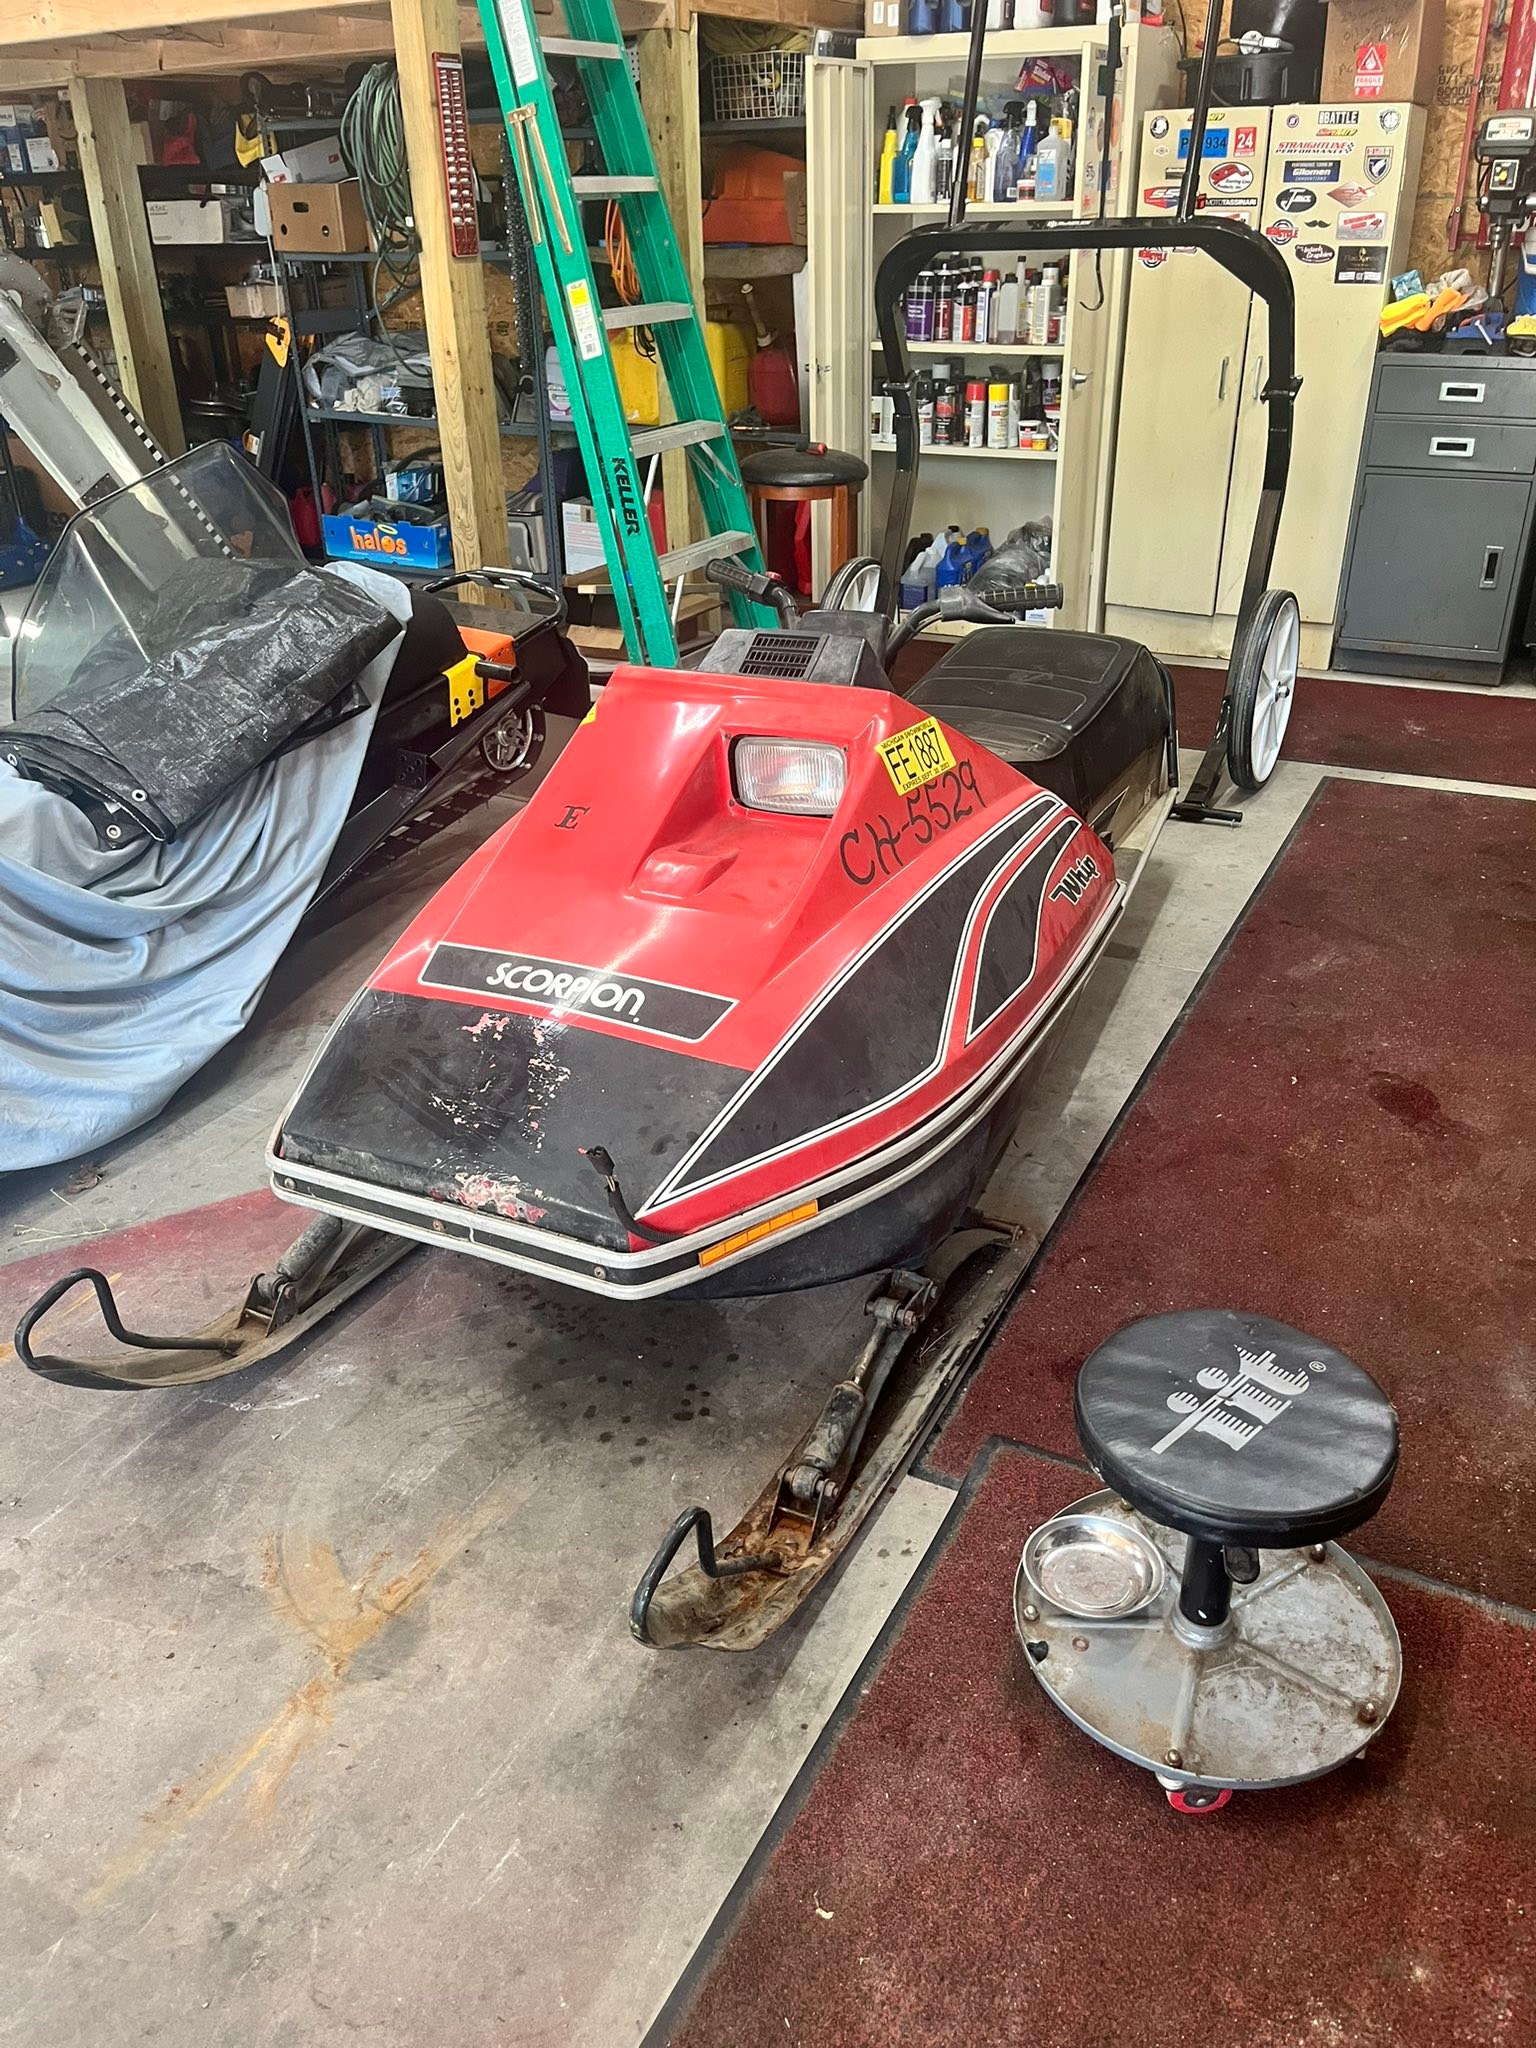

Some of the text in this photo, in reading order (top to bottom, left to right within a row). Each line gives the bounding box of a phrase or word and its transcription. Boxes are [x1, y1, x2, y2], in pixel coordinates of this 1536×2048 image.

[1237, 133, 1254, 149] 24
[1278, 141, 1346, 149] STRAIGHTLINE
[1292, 168, 1331, 176] Gilomen
[612, 458, 640, 536] KELLER
[349, 526, 407, 555] halos
[881, 720, 932, 749] MICHIGAN SNOWMOBILE
[902, 778, 922, 791] EXPIRES
[554, 805, 591, 830] E
[1051, 855, 1100, 904] Whip
